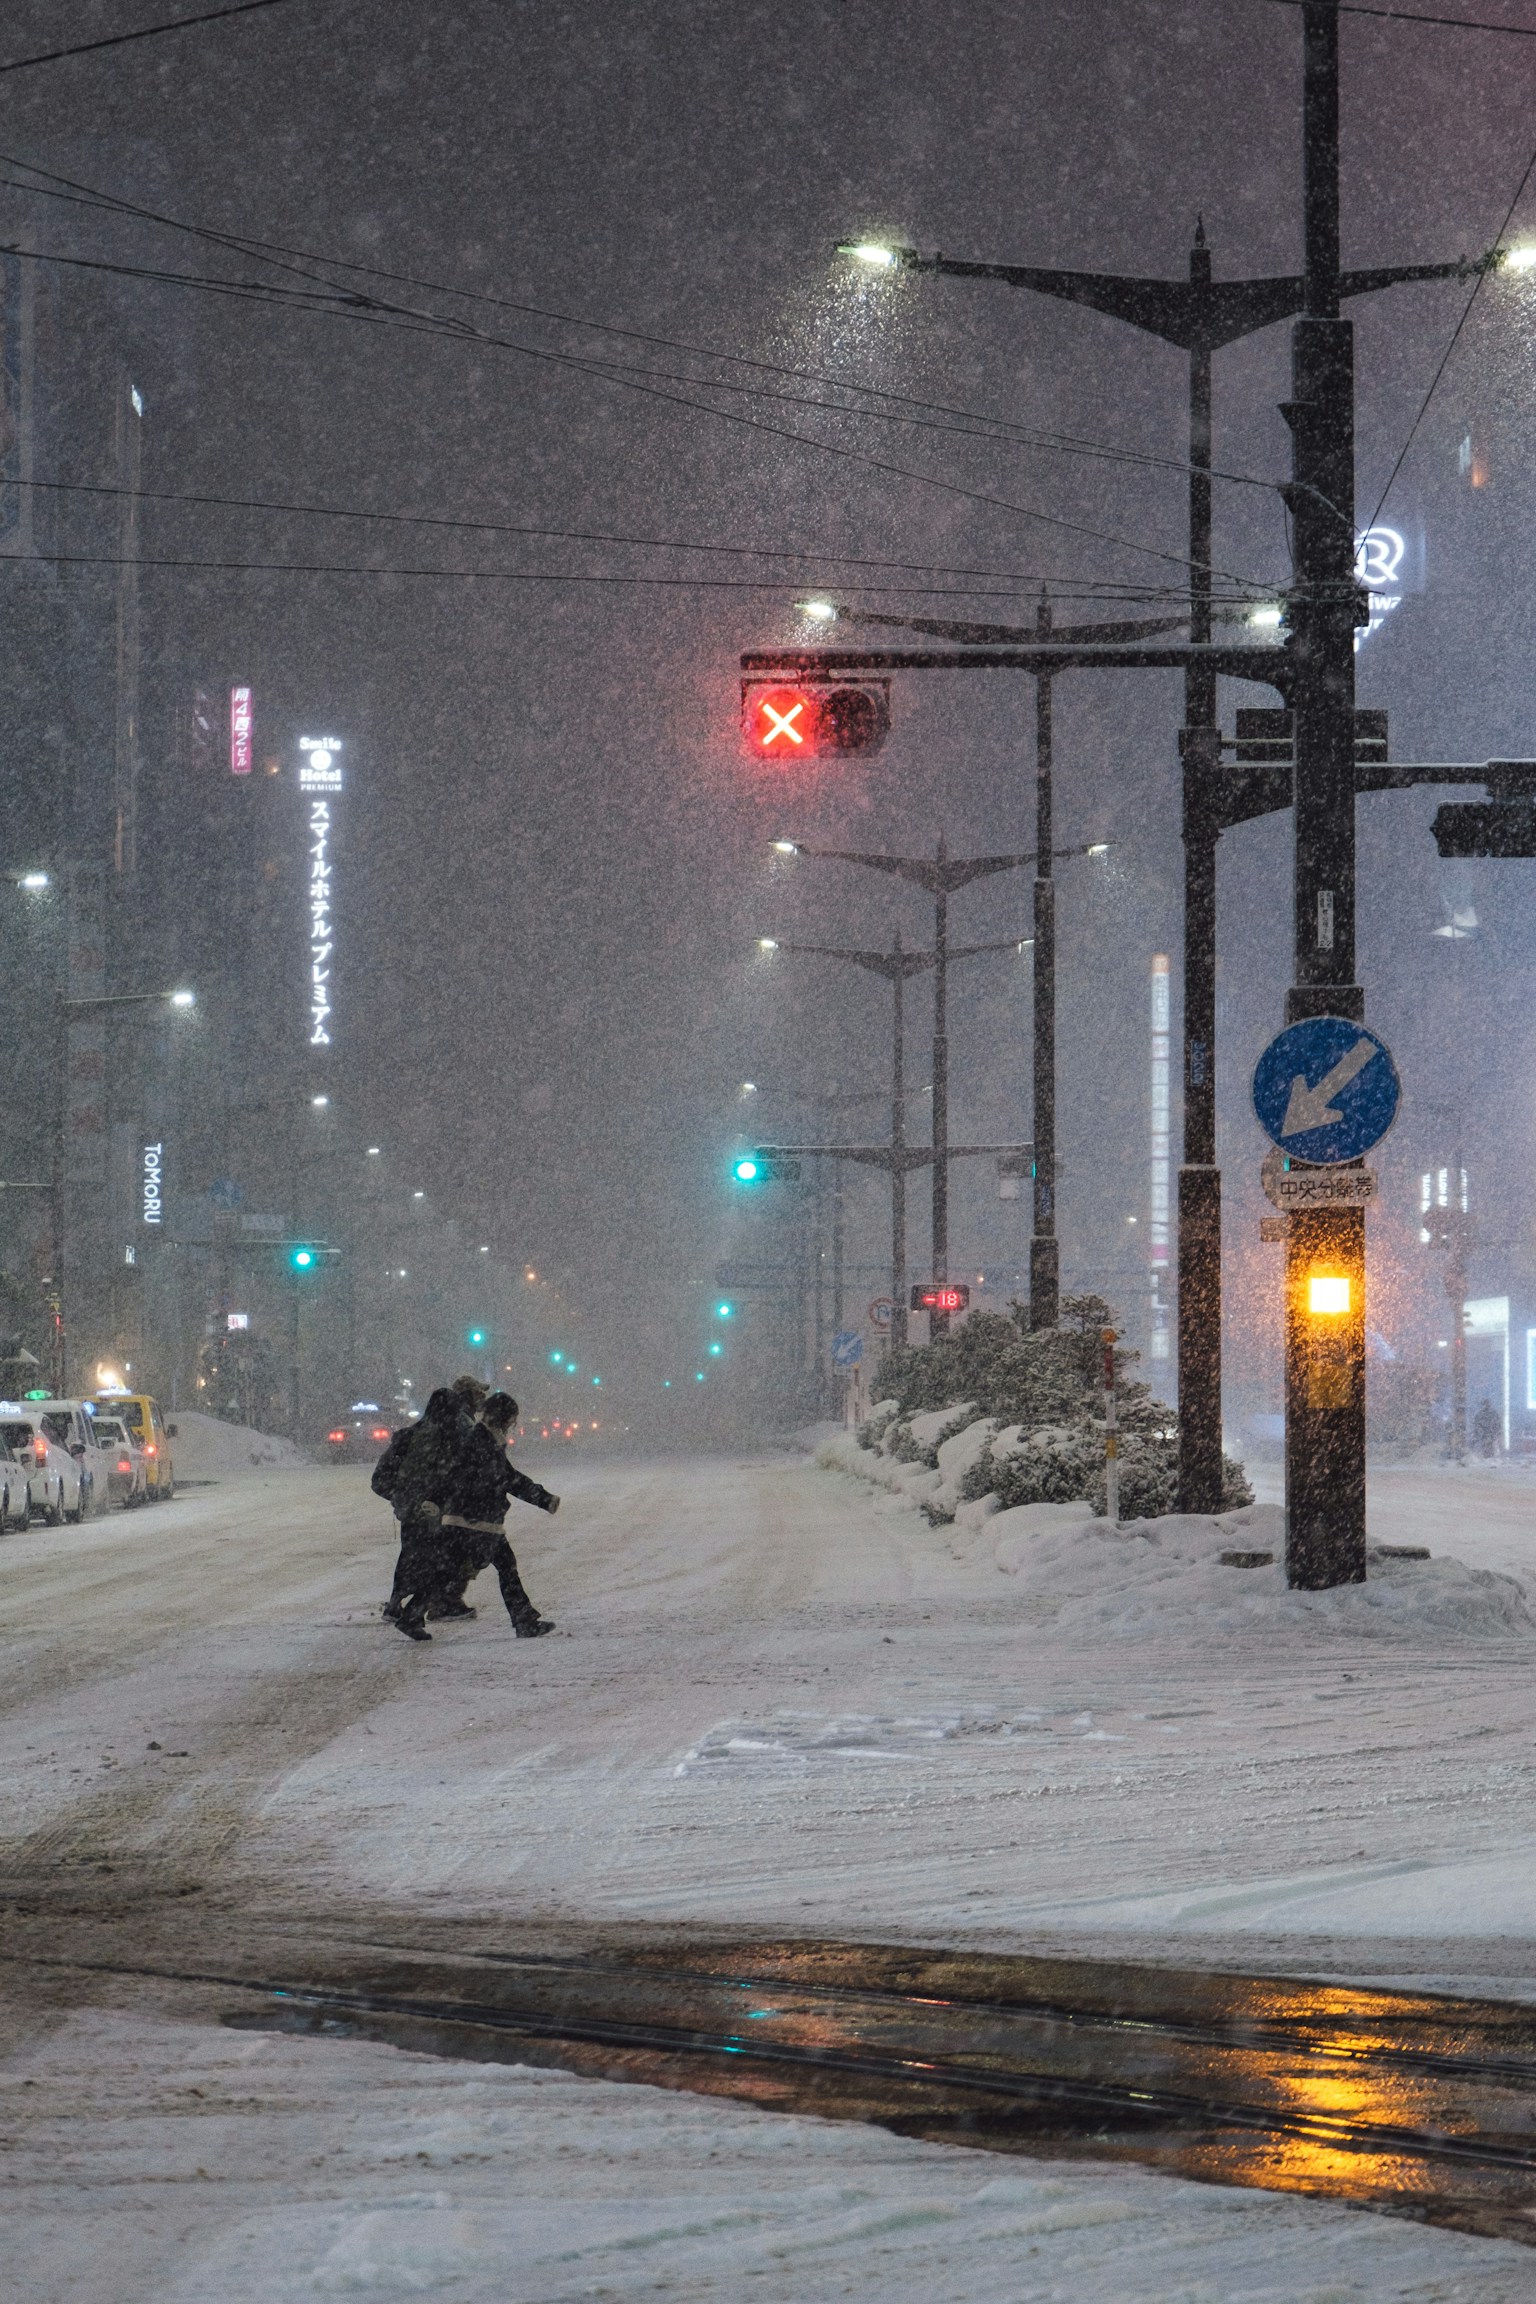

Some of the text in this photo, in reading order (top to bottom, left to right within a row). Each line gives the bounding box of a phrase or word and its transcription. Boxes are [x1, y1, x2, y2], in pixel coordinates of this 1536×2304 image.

[299, 736, 342, 750] Smile
[299, 768, 342, 782] Hotel
[300, 783, 342, 791] PREMIUM
[310, 800, 332, 1045] スマイルホテルプレミアム
[144, 1143, 162, 1223] TOMORU
